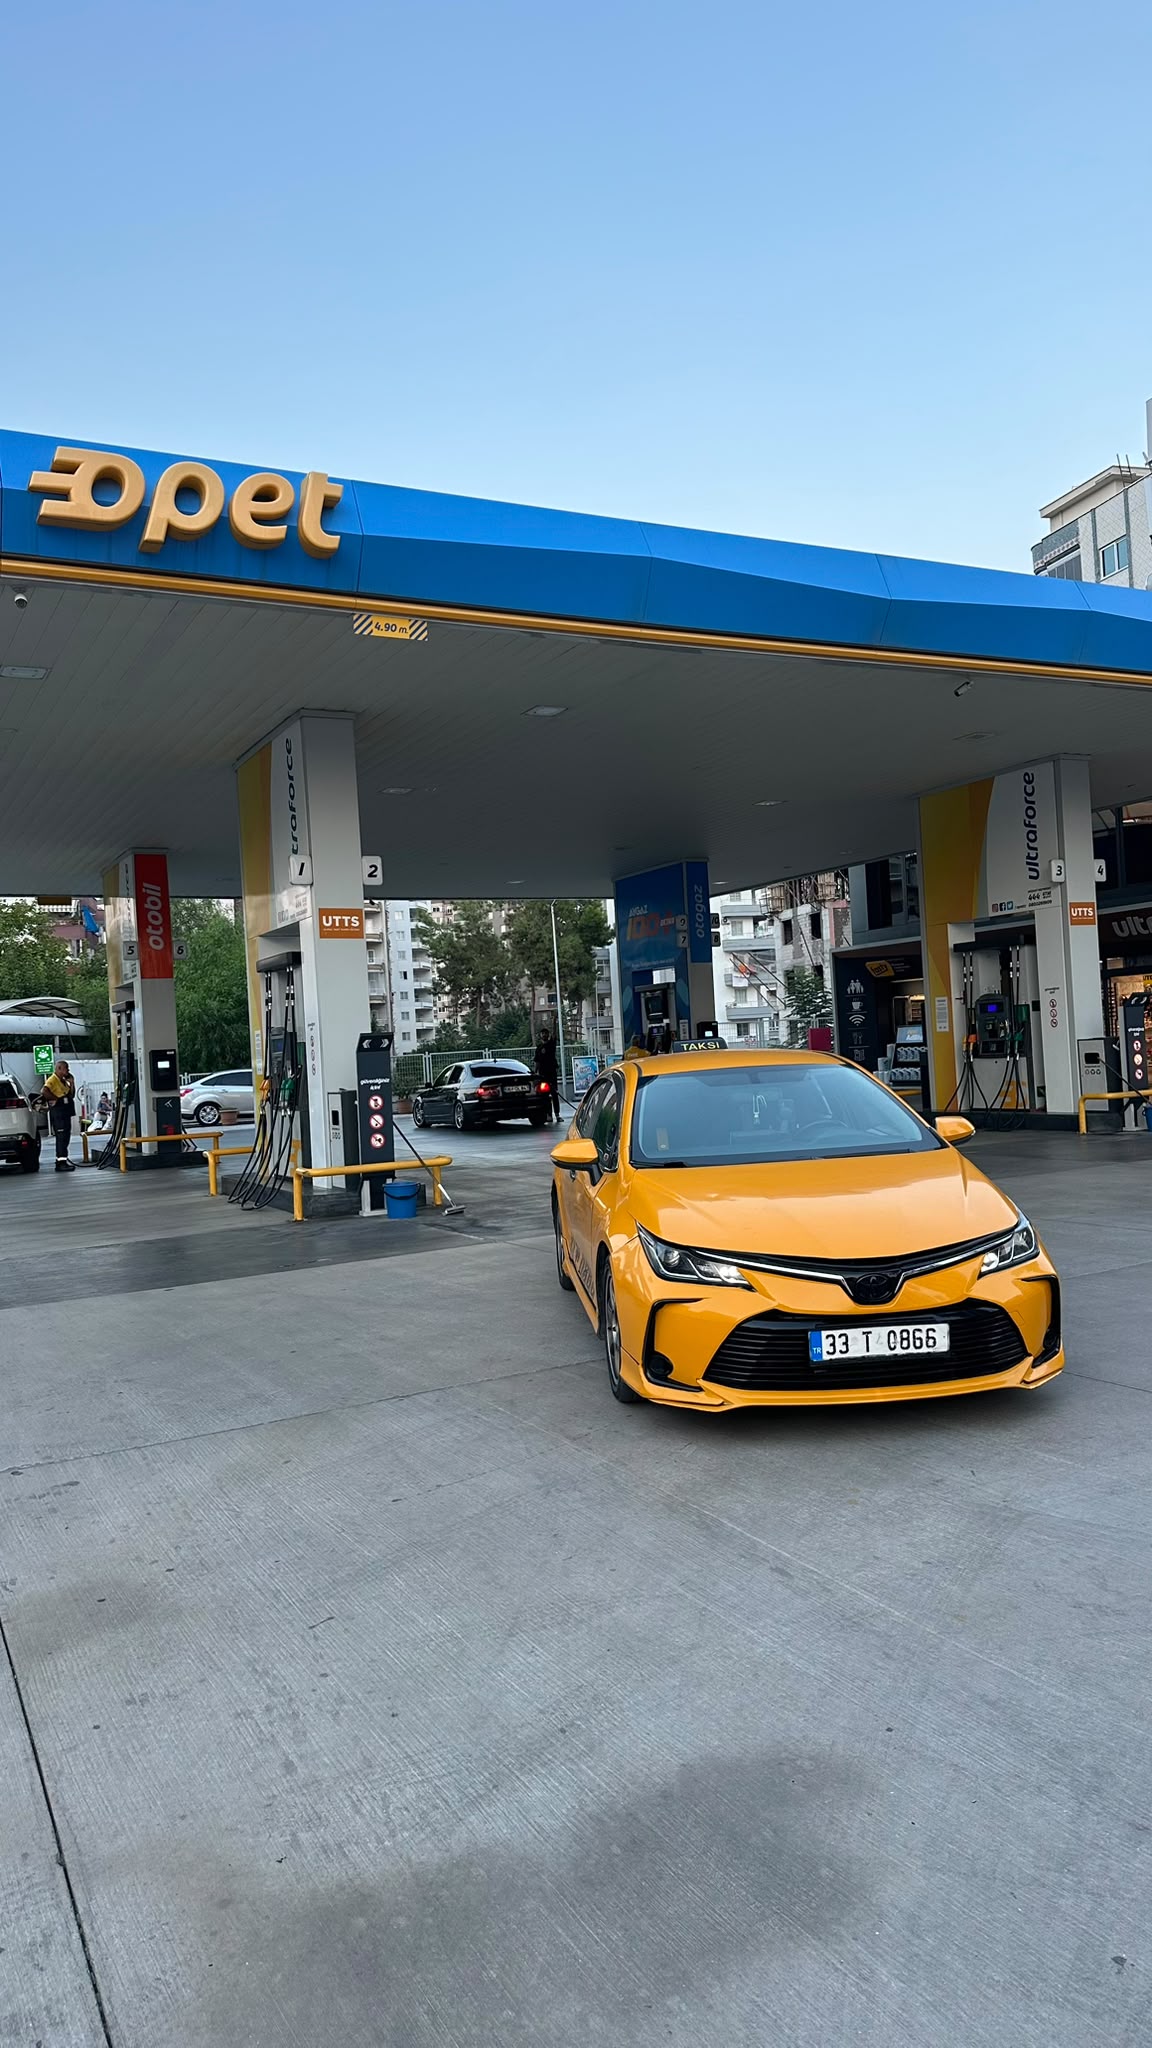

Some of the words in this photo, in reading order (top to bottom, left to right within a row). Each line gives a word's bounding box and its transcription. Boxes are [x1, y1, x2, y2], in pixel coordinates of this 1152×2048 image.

[28, 446, 344, 559] opet
[374, 621, 397, 634] 4.90
[1023, 771, 1040, 881] ultraforce
[298, 862, 305, 876] 1
[367, 864, 378, 878] 2
[1056, 865, 1063, 876] 3
[1097, 864, 1104, 876] 4
[143, 882, 164, 951] otobil
[694, 884, 707, 939] otogaz
[1071, 907, 1094, 917] UTTS
[322, 915, 360, 927] UTTS
[679, 918, 685, 927] 9
[681, 936, 687, 945] 7
[127, 945, 136, 955] 5
[176, 945, 185, 955] 6
[681, 1041, 720, 1051] TAKSI
[825, 1333, 849, 1355] 33
[862, 1331, 872, 1353] T
[887, 1328, 937, 1351] 0866
